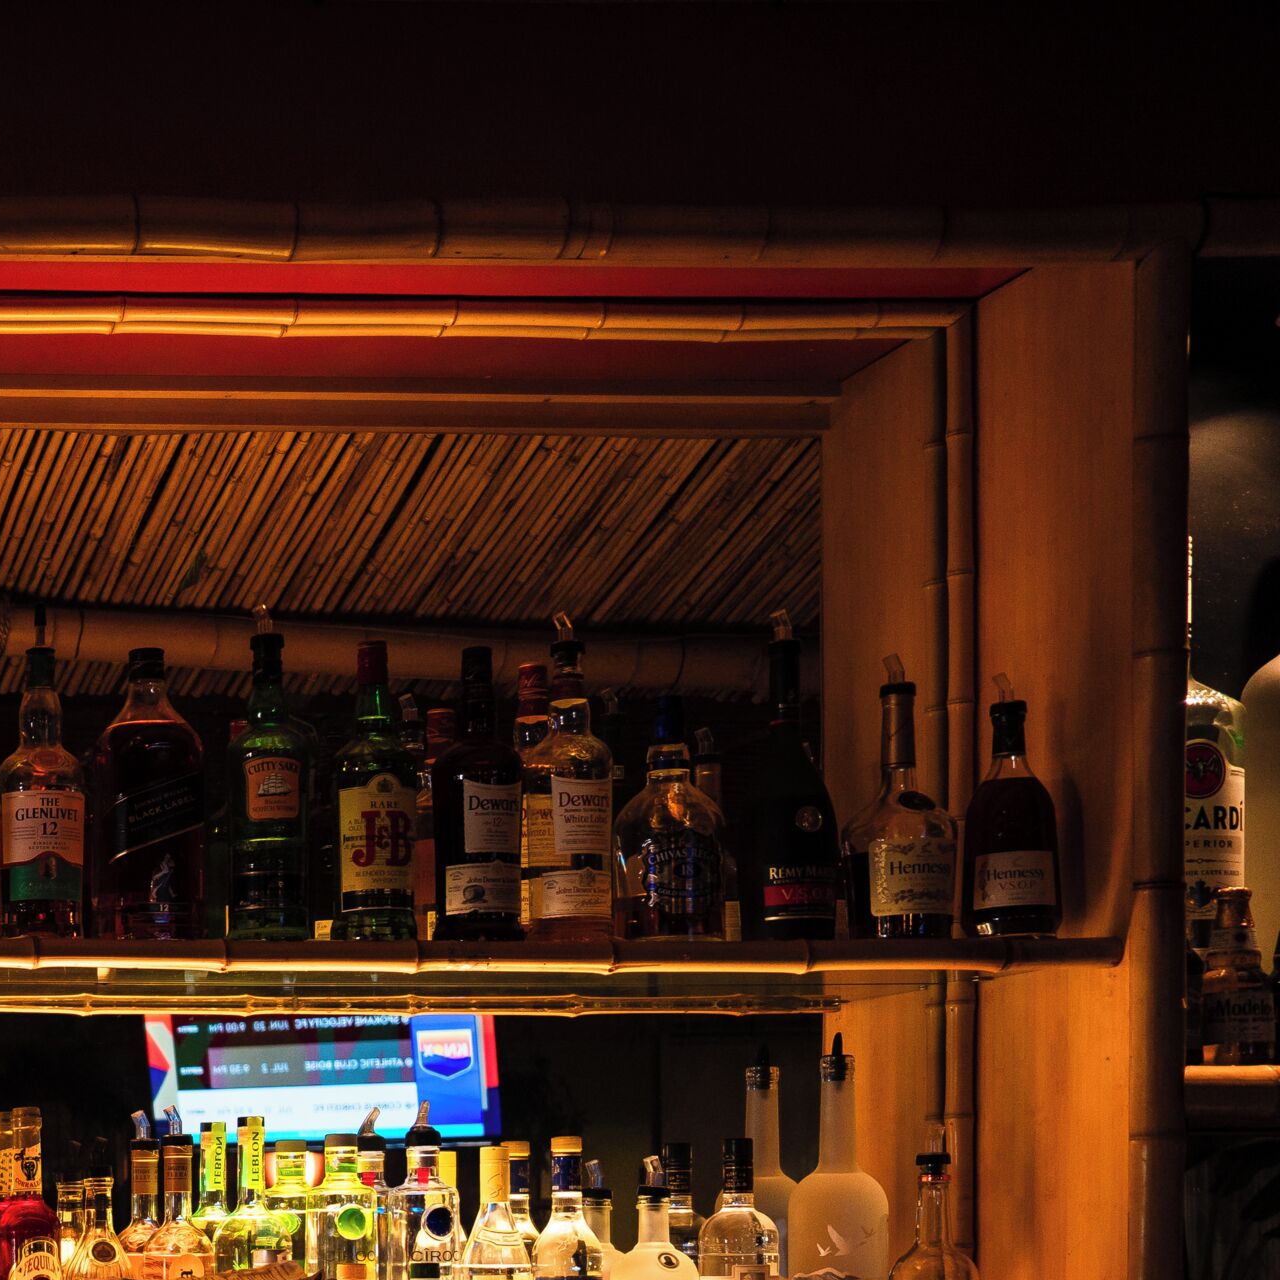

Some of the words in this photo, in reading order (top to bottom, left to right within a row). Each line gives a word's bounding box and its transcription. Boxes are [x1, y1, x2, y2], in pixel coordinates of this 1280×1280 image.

[39, 797, 60, 807] THE
[370, 800, 401, 809] RARE
[15, 807, 79, 822] GLENLIVET
[563, 815, 590, 824] White
[41, 821, 58, 836] 12
[678, 863, 695, 876] 18
[986, 867, 1045, 882] Hennessy
[159, 903, 169, 912] 12
[1210, 999, 1273, 1018] Modelo
[251, 1130, 260, 1183] LEBLON
